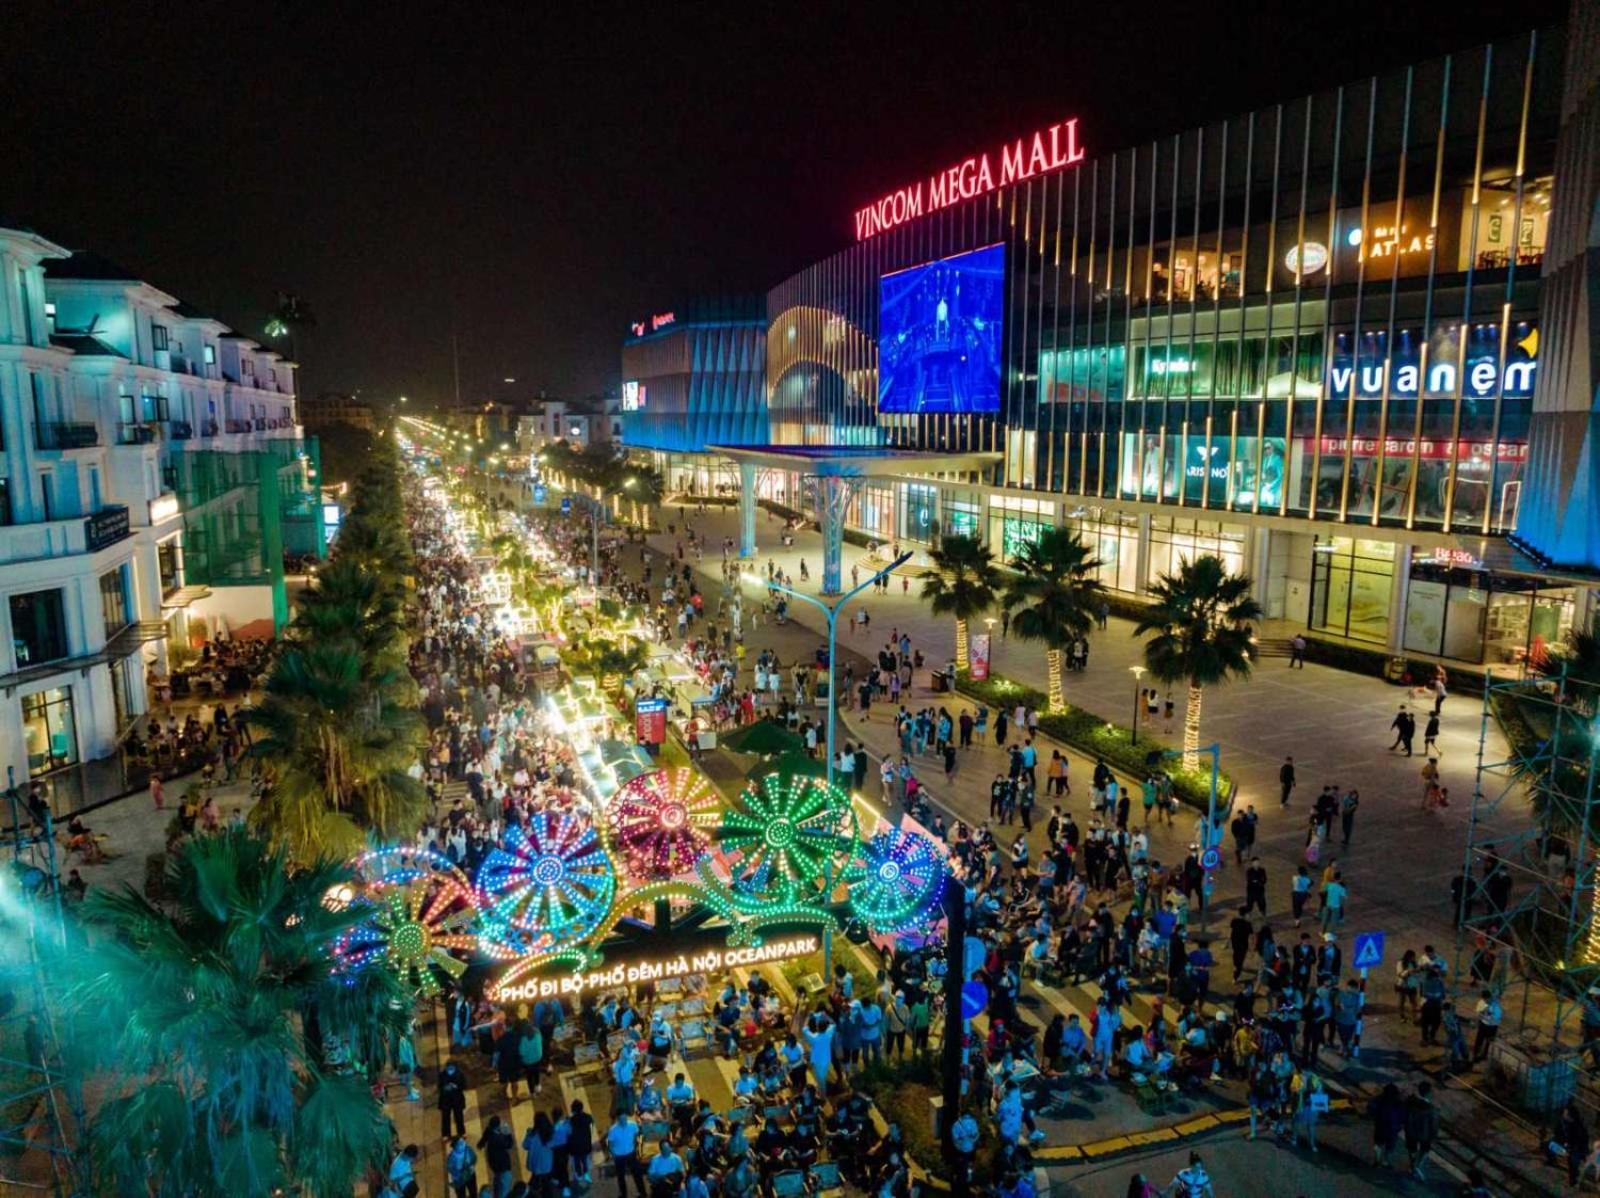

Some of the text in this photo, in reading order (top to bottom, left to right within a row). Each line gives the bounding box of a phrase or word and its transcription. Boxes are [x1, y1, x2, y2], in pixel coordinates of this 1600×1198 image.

[855, 118, 1085, 241] VINCOM MEGA MALL
[1328, 438, 1375, 453] pirre
[1186, 466, 1228, 479] RISNO
[500, 978, 538, 1003] PHỐ
[540, 979, 558, 997] ĐI
[627, 961, 663, 982] ĐÊM
[666, 955, 689, 976] HÀ
[693, 950, 722, 971] NỘI
[724, 937, 818, 967] OCEANPARK
